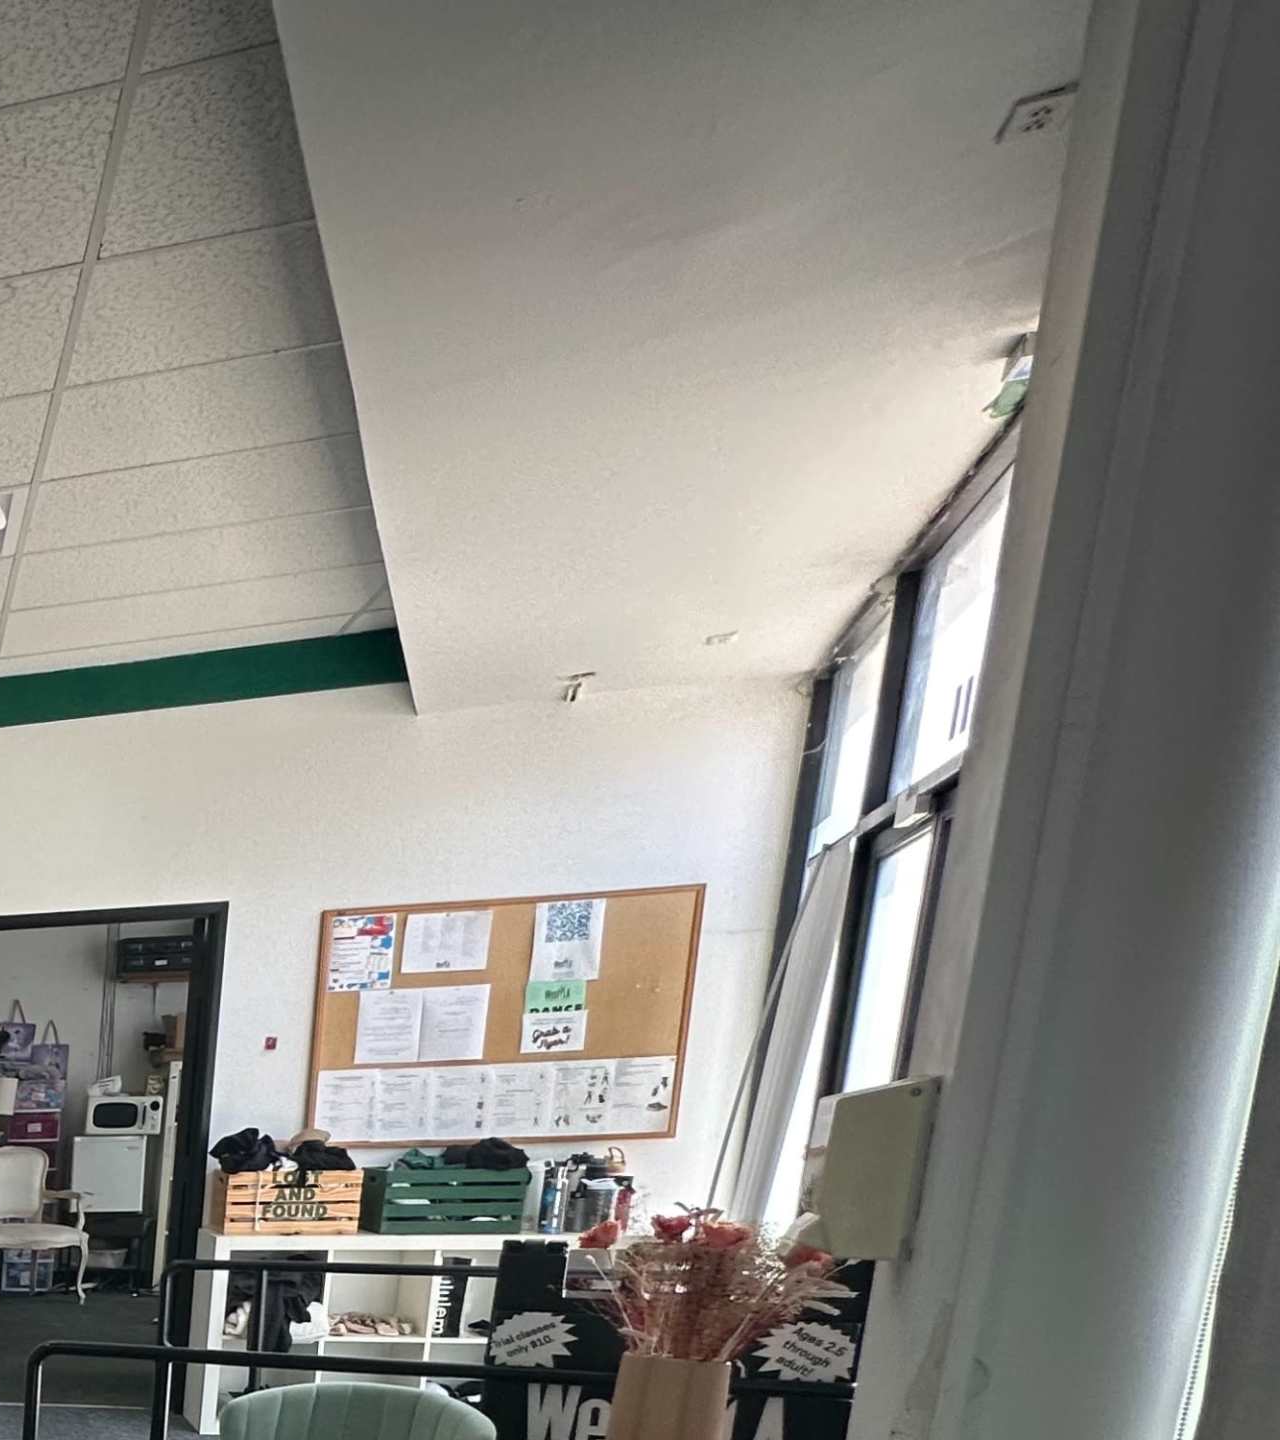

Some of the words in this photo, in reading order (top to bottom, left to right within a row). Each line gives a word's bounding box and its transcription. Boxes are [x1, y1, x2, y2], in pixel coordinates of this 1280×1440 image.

[532, 1026, 560, 1043] Grab
[275, 1187, 316, 1201] AND
[262, 1204, 329, 1217] FOUND
[792, 1327, 824, 1347] Ages
[783, 1340, 831, 1368] through
